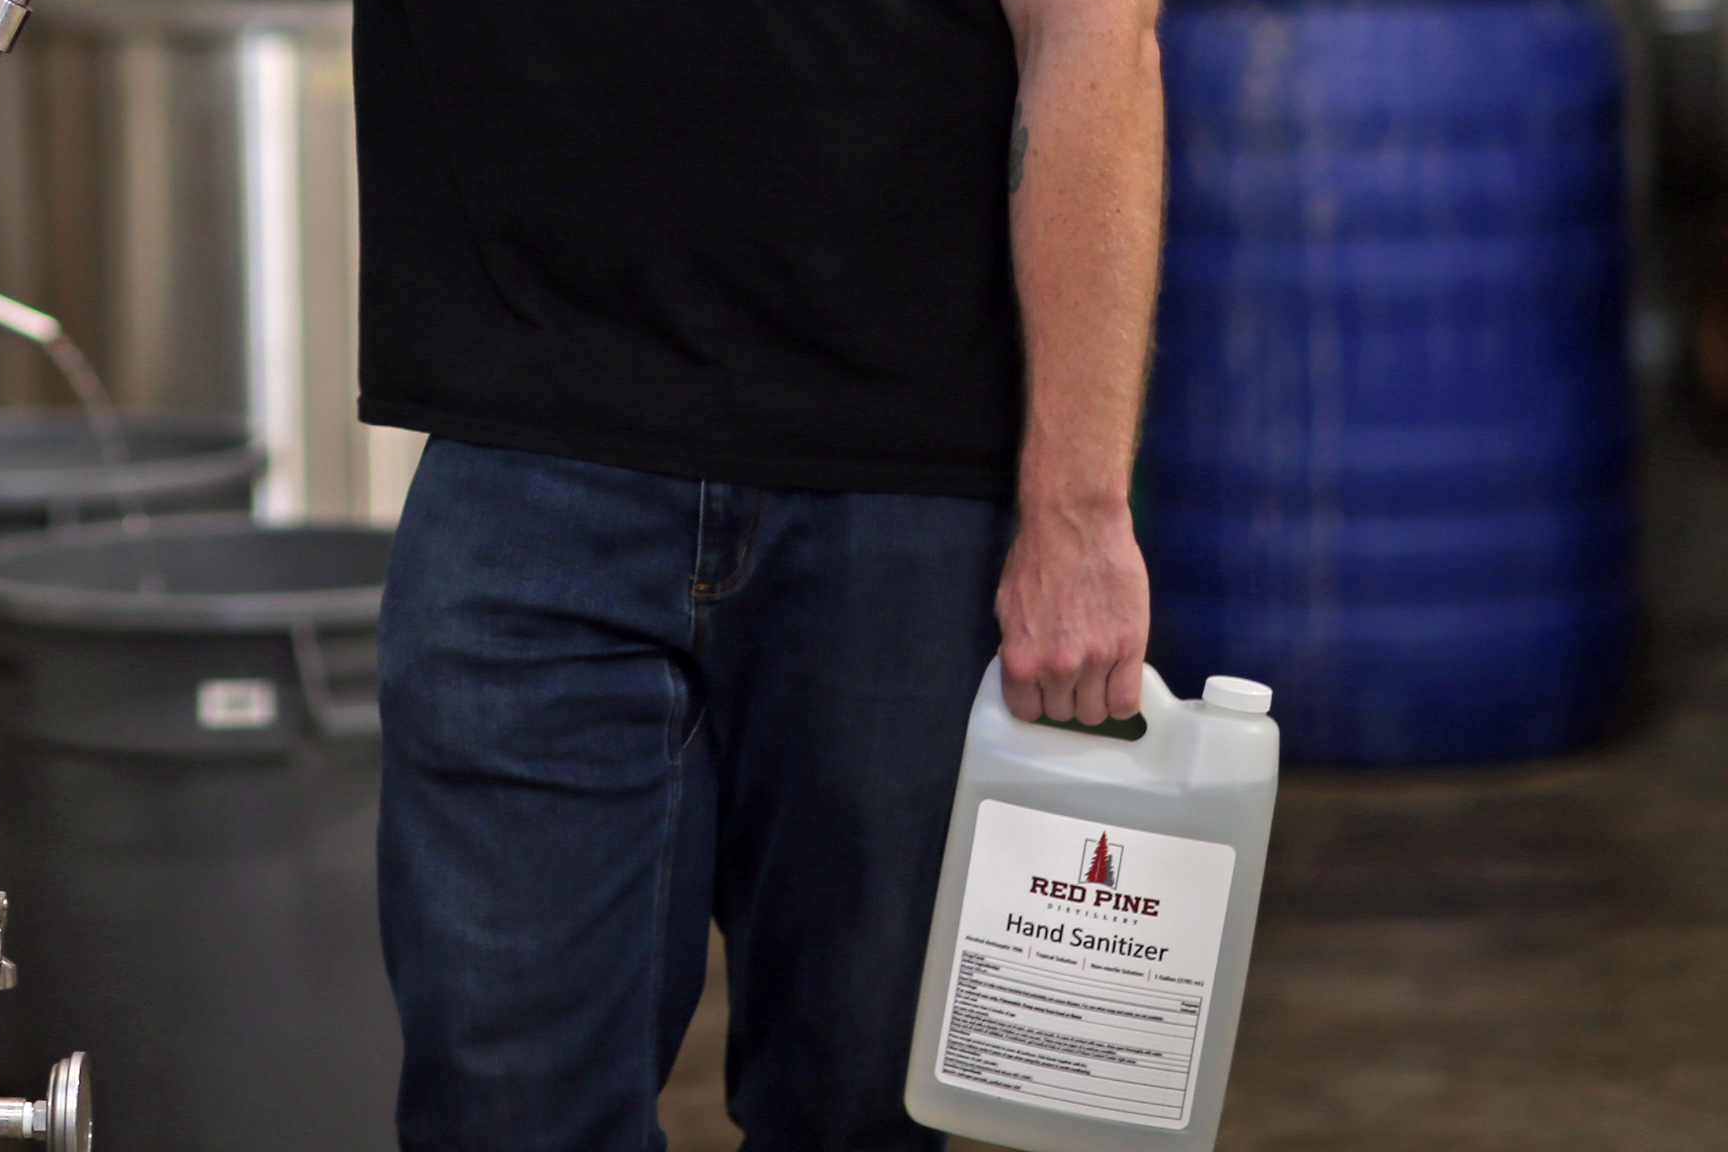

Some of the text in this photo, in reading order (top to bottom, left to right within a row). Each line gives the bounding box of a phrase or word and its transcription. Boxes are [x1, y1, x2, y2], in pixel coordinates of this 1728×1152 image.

[1029, 875, 1160, 917] RED PINE
[1047, 903, 1139, 926] DISTILLERY
[1006, 912, 1169, 962] Hand Sanitizer
